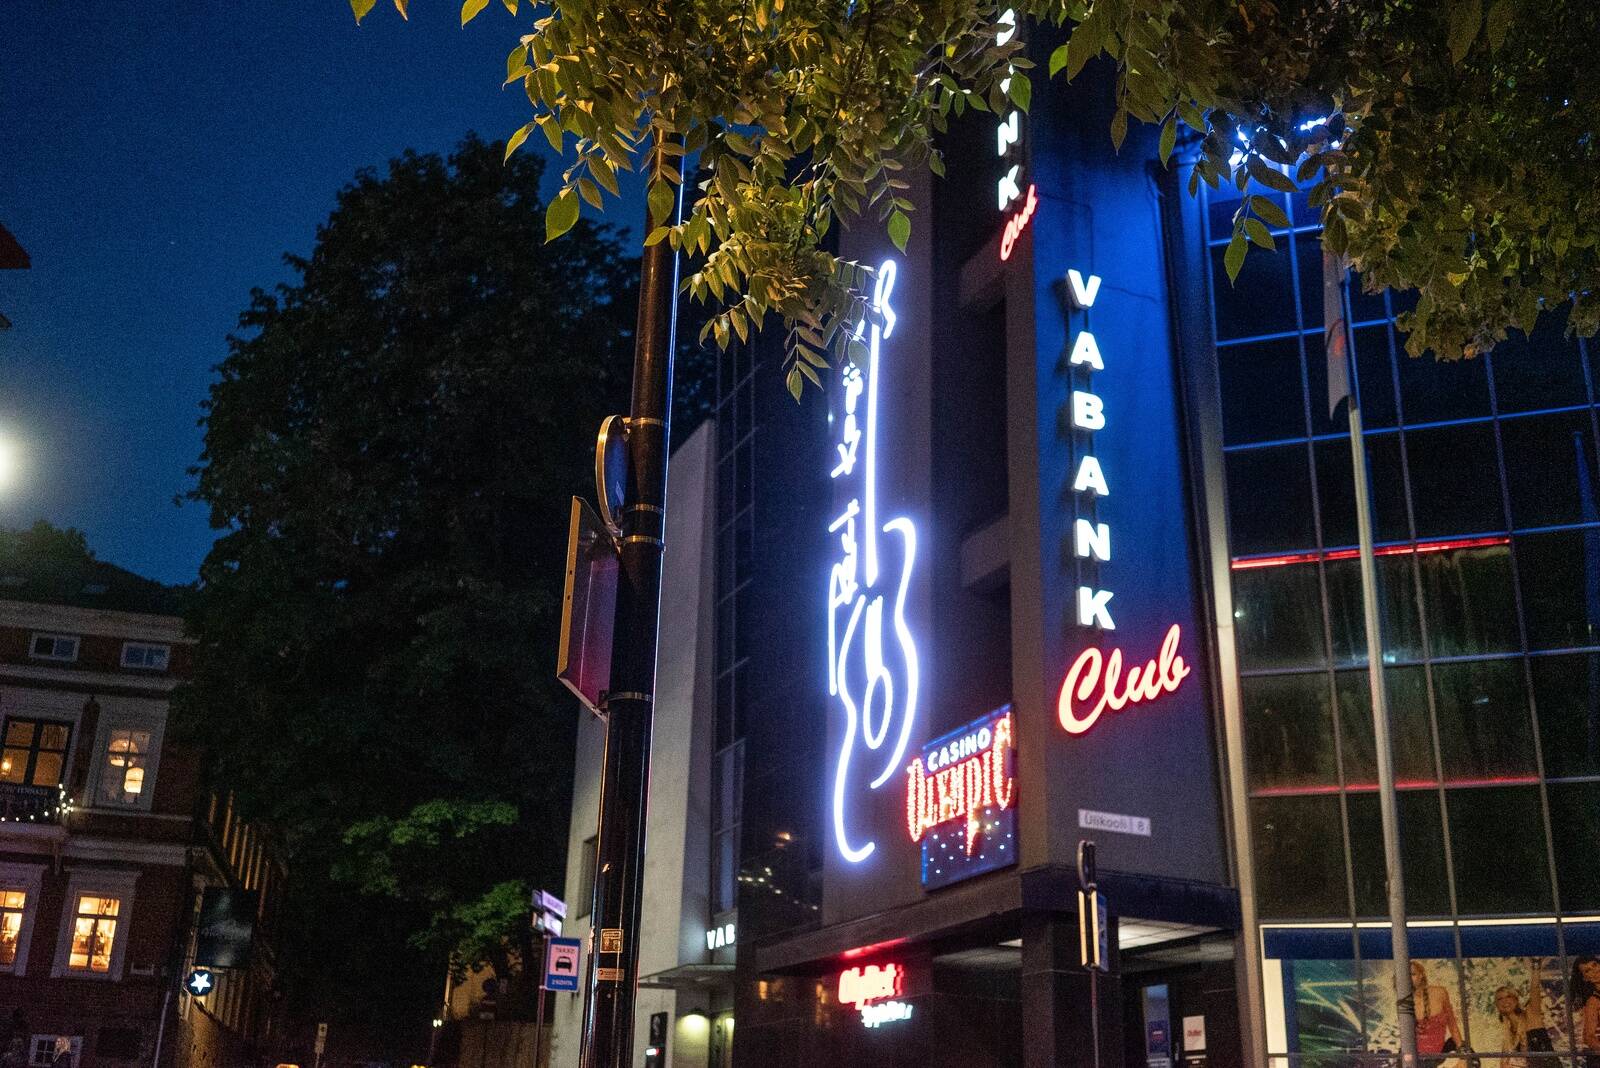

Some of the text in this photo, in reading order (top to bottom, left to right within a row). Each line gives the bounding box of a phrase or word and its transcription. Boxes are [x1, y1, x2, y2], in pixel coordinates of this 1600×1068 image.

[1066, 268, 1116, 631] VABANK
[1058, 623, 1191, 734] Club
[926, 726, 992, 773] CASINO
